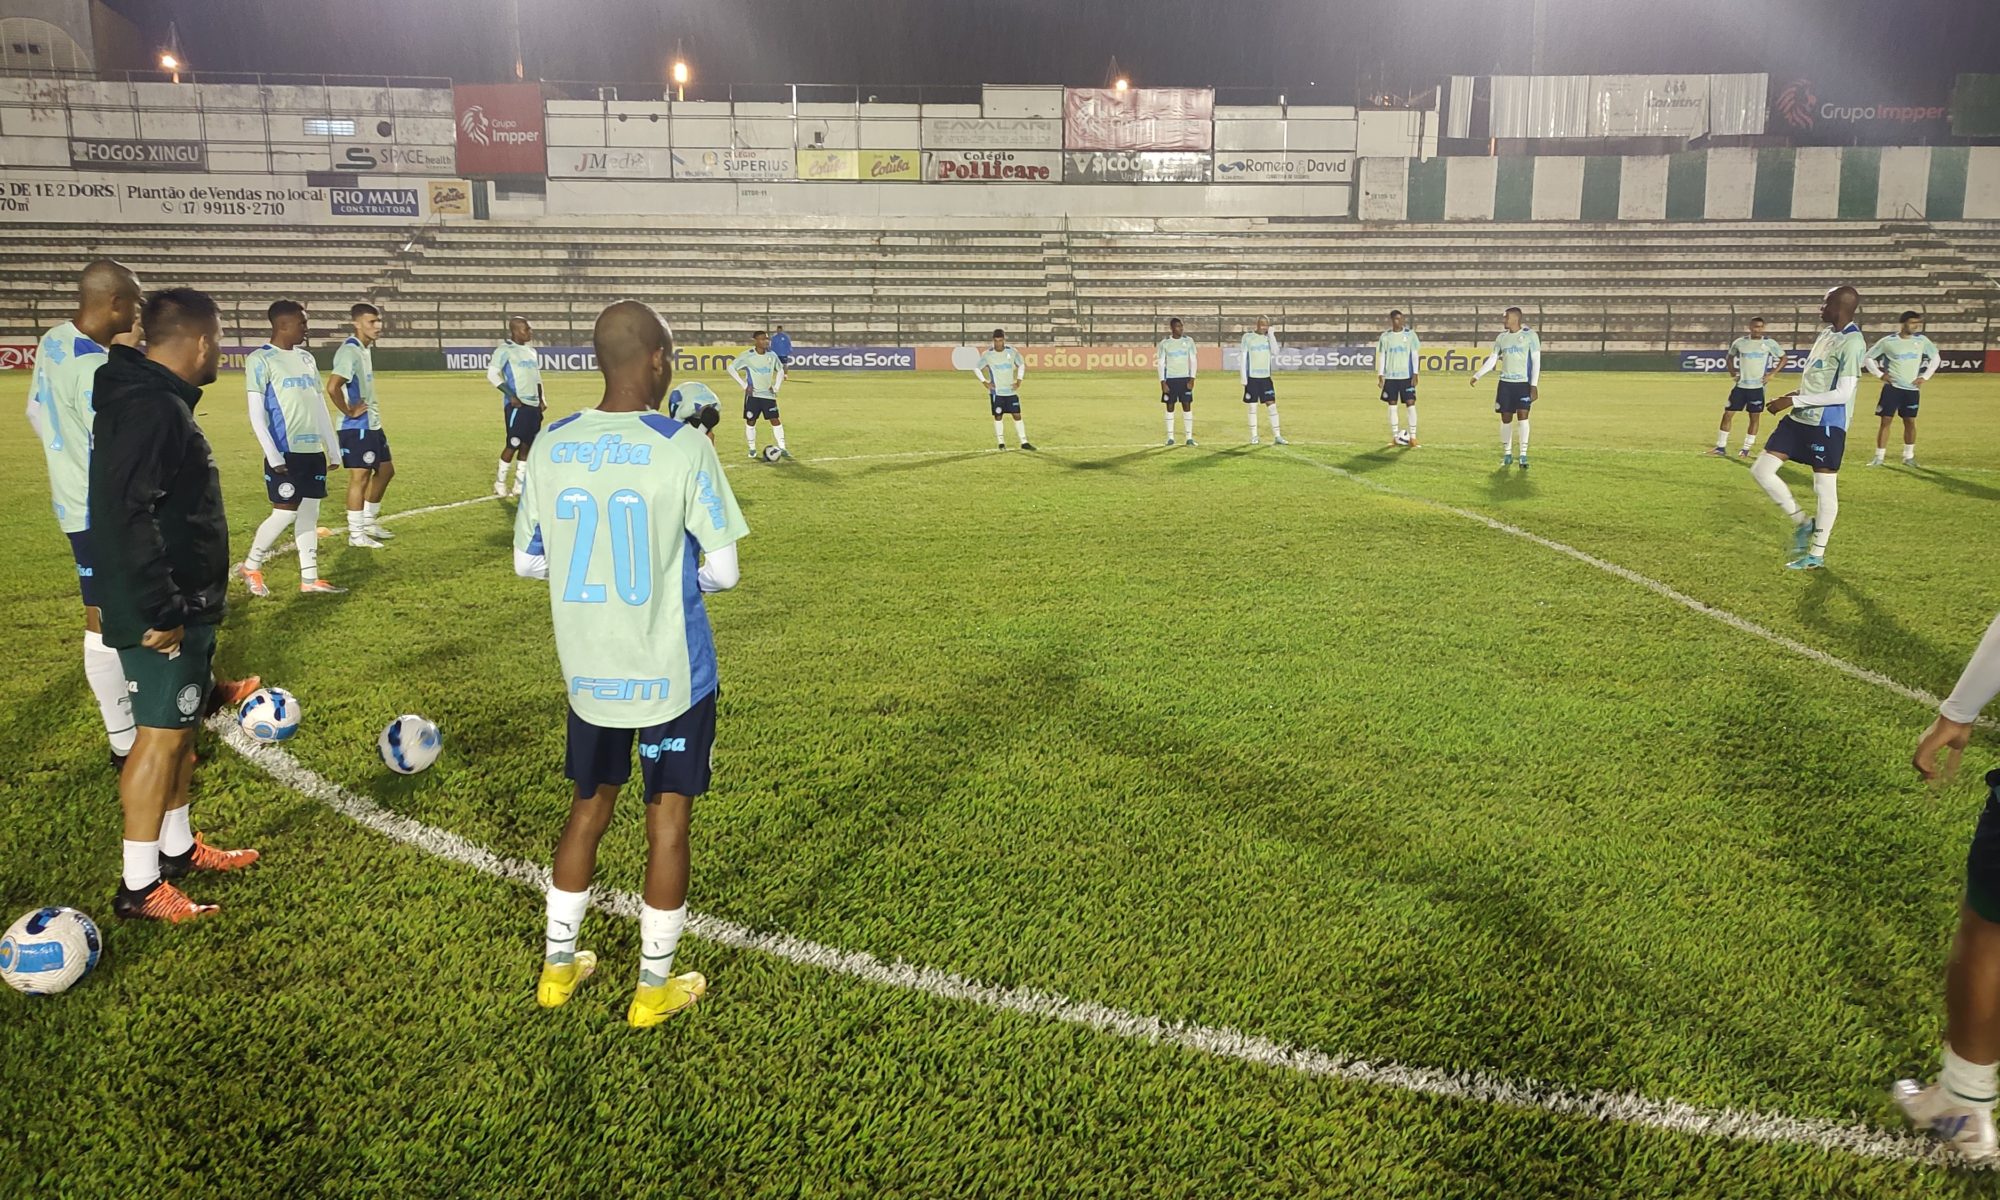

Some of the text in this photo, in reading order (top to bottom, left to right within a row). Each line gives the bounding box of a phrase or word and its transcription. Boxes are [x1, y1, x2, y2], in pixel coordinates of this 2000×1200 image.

[1820, 103, 1945, 122] Grupo Impper
[491, 119, 517, 129] Grupo
[933, 121, 1051, 130] CAVALARI
[492, 129, 539, 144] Impper
[88, 143, 199, 161] FOGOS XINGU
[380, 148, 452, 165] SPACE health
[963, 151, 1015, 161] Colégio
[723, 159, 789, 171] SUPERIUS
[871, 159, 910, 178] Cotuba
[938, 160, 1050, 180] Pollicare
[1245, 158, 1294, 173] Romero
[1307, 159, 1347, 173] David
[10, 182, 31, 197] DE
[44, 183, 54, 197] E
[56, 183, 66, 197] 2
[127, 185, 185, 200] Plantão
[189, 186, 207, 200] de
[207, 187, 262, 201] Vendas
[266, 189, 285, 201] no
[332, 190, 364, 204] RIO
[340, 205, 412, 214] CONSTRUTORA
[864, 354, 911, 367] Sorte
[1043, 350, 1081, 367] são
[1086, 350, 1148, 370] paulo
[1326, 353, 1374, 366] Sorte
[1940, 359, 1983, 369] PLAY
[551, 434, 652, 472] crefisa
[556, 487, 652, 606] 20
